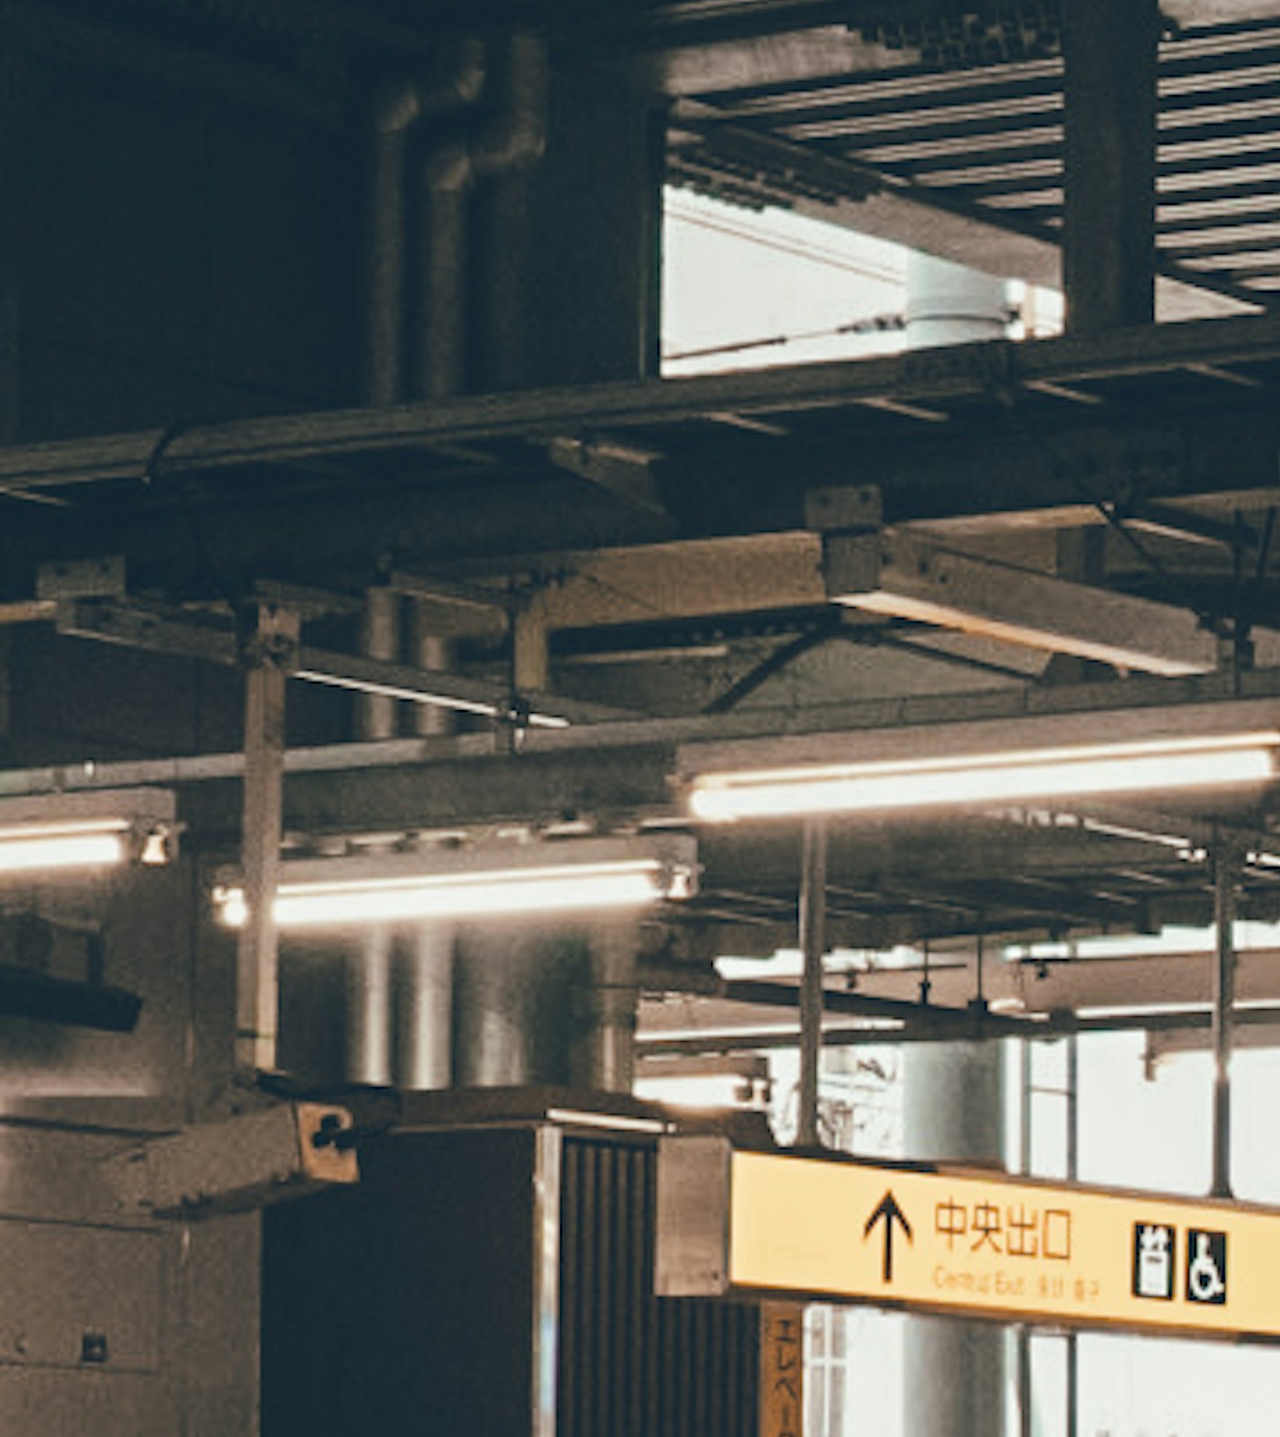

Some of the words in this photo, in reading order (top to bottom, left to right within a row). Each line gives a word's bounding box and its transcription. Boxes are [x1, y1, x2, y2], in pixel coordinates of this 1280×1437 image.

[934, 1195, 1072, 1262] 中央出口
[994, 1270, 1025, 1296] Exit
